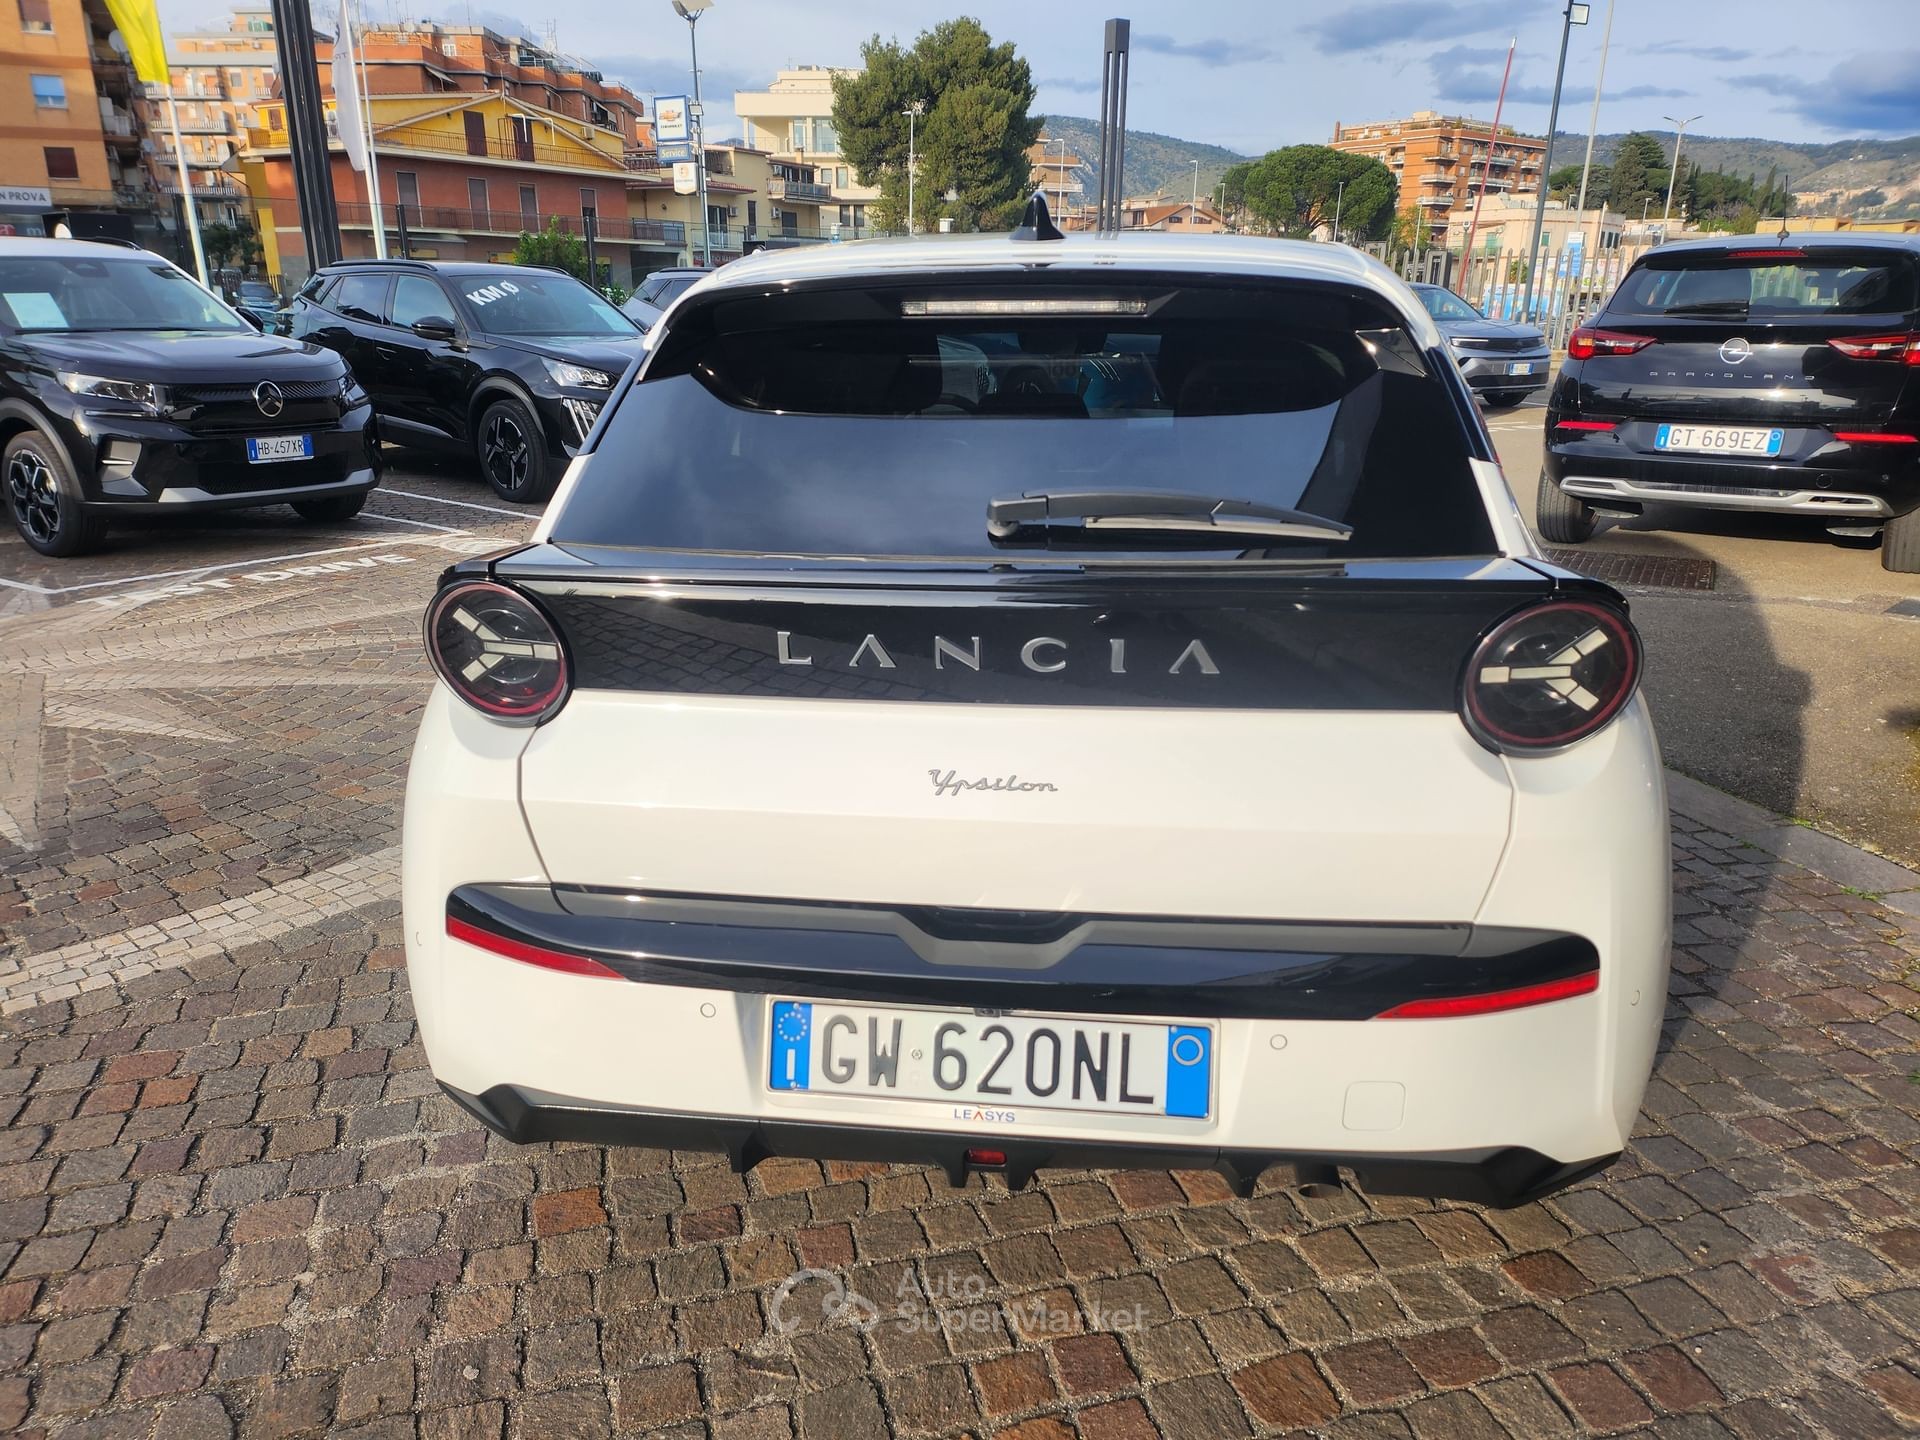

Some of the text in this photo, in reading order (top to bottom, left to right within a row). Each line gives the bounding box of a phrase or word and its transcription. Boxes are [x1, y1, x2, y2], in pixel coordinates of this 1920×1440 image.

[9, 192, 47, 201] PROVA
[466, 285, 508, 305] KM
[1649, 372, 1815, 381] GRANDLAND
[1670, 427, 1696, 447] GT
[1701, 430, 1768, 451] 669EZ
[242, 554, 416, 582] DRIVE
[776, 631, 1221, 675] LANCIA
[928, 769, 1058, 797] Ypsilon
[821, 1013, 903, 1088] GW
[932, 1020, 1156, 1105] 620NL
[953, 1107, 1016, 1123] LEASYS
